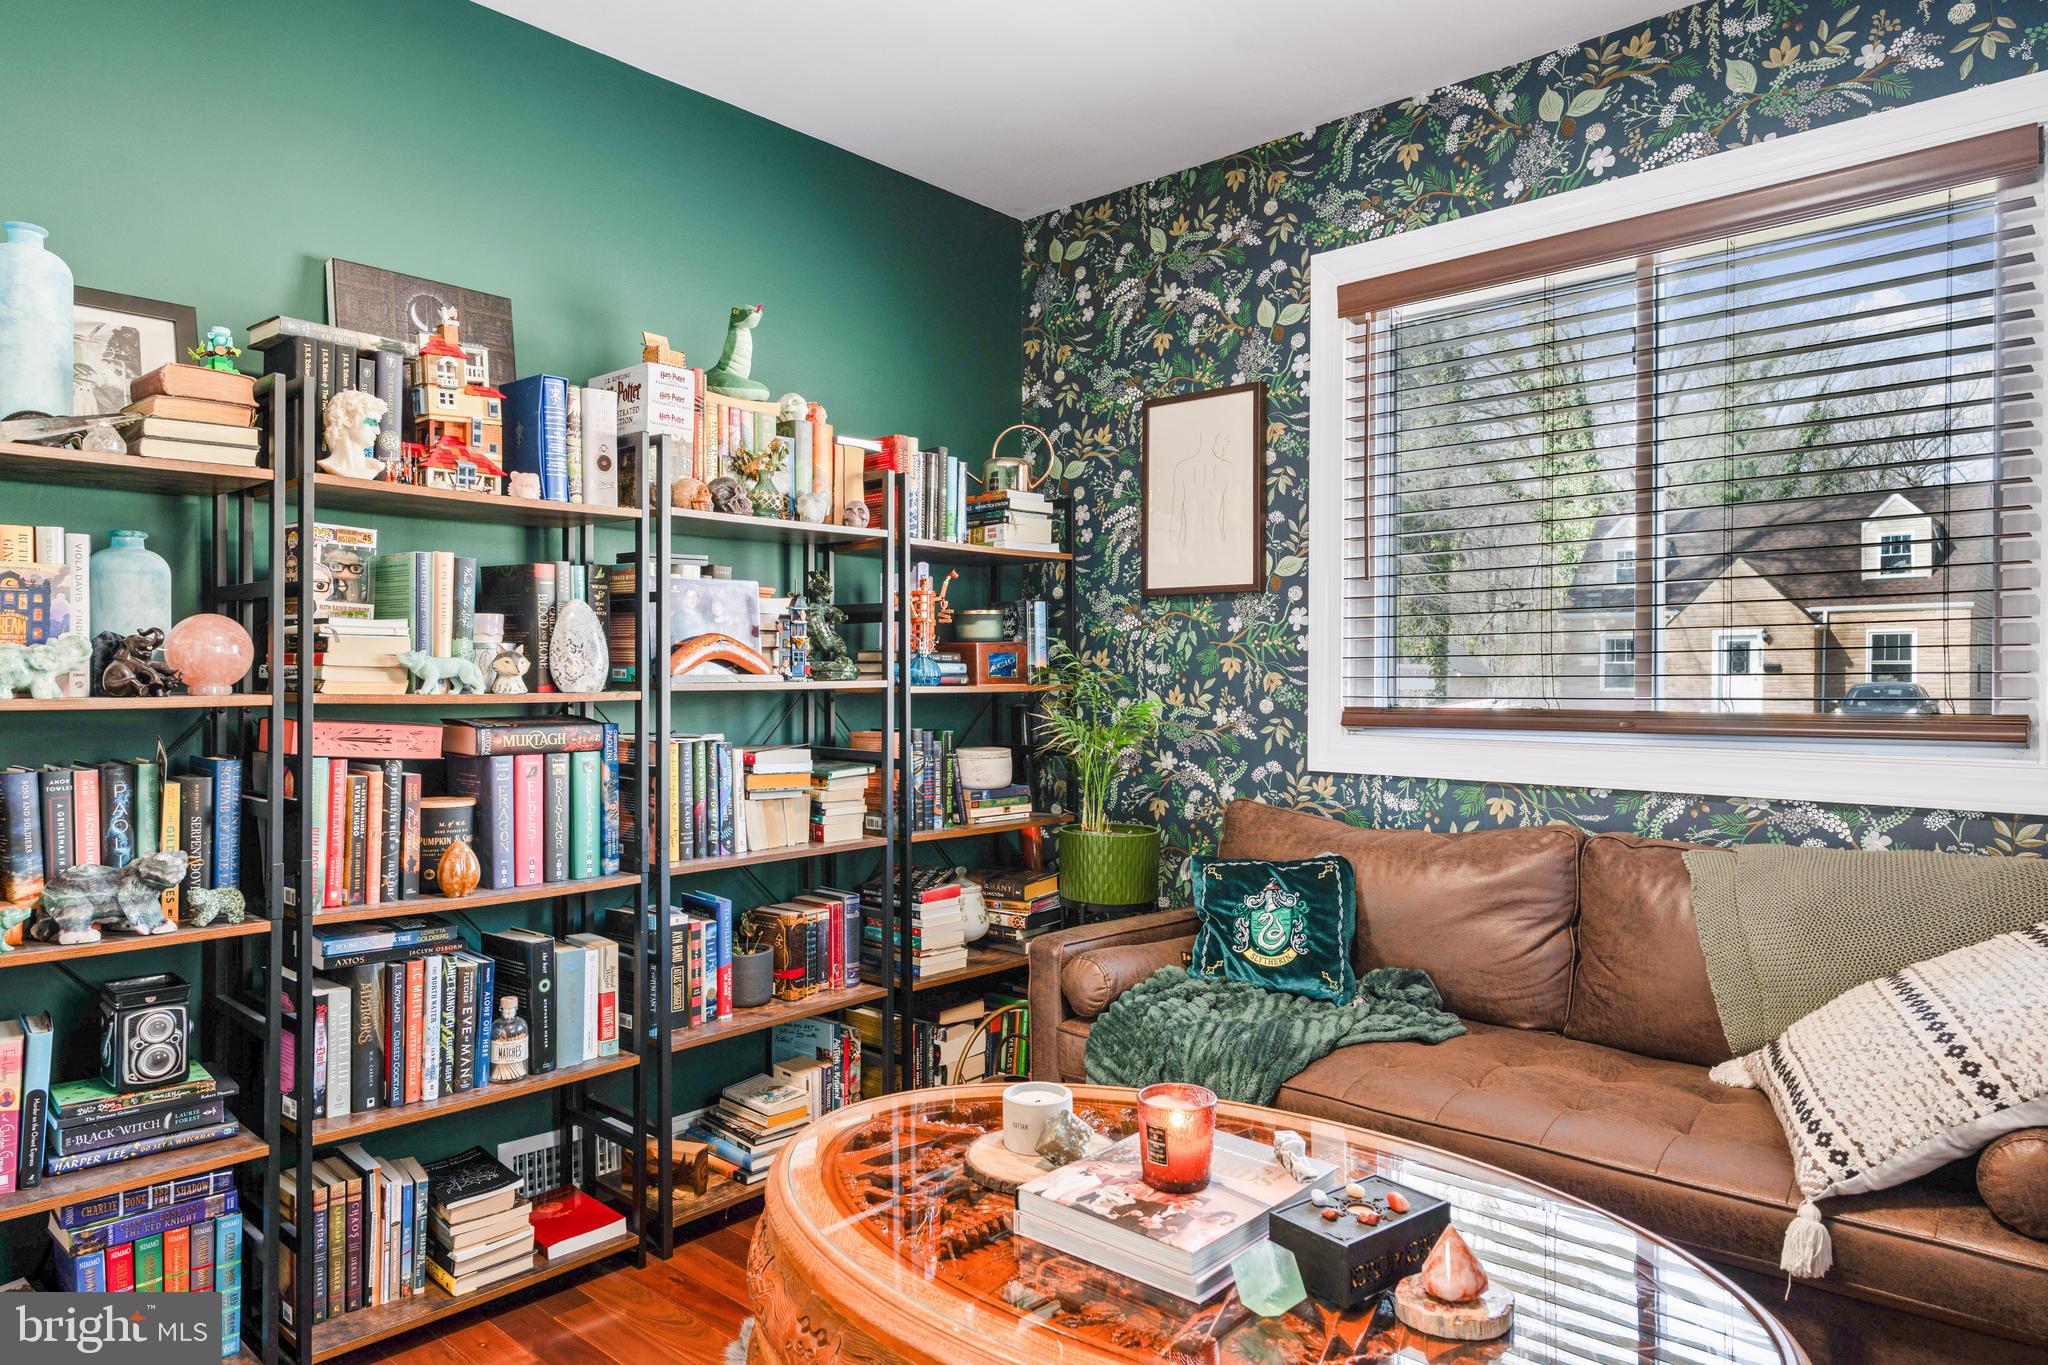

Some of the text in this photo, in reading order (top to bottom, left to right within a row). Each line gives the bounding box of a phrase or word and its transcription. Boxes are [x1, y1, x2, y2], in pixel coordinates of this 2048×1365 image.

[612, 372, 631, 382] ROWLING
[672, 373, 686, 383] Potter
[617, 381, 642, 403] Potter
[672, 394, 686, 404] Potter
[671, 414, 685, 424] Potter
[362, 533, 373, 543] 45
[75, 543, 83, 602] VIOLA DAVIS
[440, 571, 448, 635] PLACE FOR US
[456, 586, 473, 628] Paris Slept
[538, 593, 549, 670] BLOOD BONE
[990, 655, 1016, 673] ACID
[503, 729, 567, 750] MURTAGH
[605, 728, 614, 762] PAOLINI
[220, 766, 232, 813] SCHWAB
[333, 786, 342, 815] WHITE
[390, 787, 398, 812] SHOULD
[606, 770, 619, 821] ERAGON
[22, 780, 33, 854] SONS AND SOLDIERS
[353, 784, 362, 837] EVELYN HUGO
[390, 814, 398, 822] BE
[497, 785, 510, 853] ERAGON
[528, 780, 537, 848] ELDEST
[555, 778, 564, 849] BRISINGR
[57, 810, 66, 855] GENTLEMAN
[332, 818, 341, 842] LADY
[389, 825, 397, 841] WILD
[710, 801, 718, 846] GUEST LIST
[85, 812, 95, 866] JACQUELINE
[191, 816, 202, 861] SERPENT
[219, 814, 231, 872] OF ADDIE
[420, 833, 461, 847] PUMPKIN &
[58, 857, 66, 867] IN
[387, 880, 395, 896] FINE
[416, 932, 449, 943] GOLDBERG
[420, 927, 446, 937] LORETTA
[409, 943, 463, 956] JACLYN OSBORN
[672, 930, 684, 962] AYN RAND
[335, 955, 366, 967] AXIOS
[1250, 952, 1293, 966] SLYTHERIN
[412, 966, 422, 1020] J.C. MAETIS
[430, 975, 439, 1024] NORTH WATER
[446, 961, 457, 1029] JANET EVANOVICH
[673, 968, 683, 1010] ATLAS SHRUGGED
[483, 991, 491, 1018] ALONE
[602, 1006, 615, 1040] NATIVE SON
[393, 972, 402, 1102] S.L. ROWLAND CURSED COCKTAILS
[460, 1006, 473, 1078] EVE MAN
[482, 1038, 490, 1058] HERE
[338, 1014, 349, 1090] LITTLE LIFE
[445, 1036, 453, 1082] RECOVERY AGENT
[498, 1044, 523, 1060] MATCHES
[833, 1072, 841, 1100] KITCHEN
[32, 1098, 40, 1116] Murder
[175, 1109, 201, 1119] LAURIE
[175, 1115, 201, 1126] FOREST
[30, 1131, 39, 1147] Orient
[75, 1118, 161, 1148] BLACK WITCH
[140, 1144, 151, 1153] GO
[152, 1141, 166, 1151] SET
[175, 1131, 217, 1146] WATCHMAN
[28, 1149, 38, 1168] Express
[54, 1149, 127, 1173] HARPER LEE
[81, 1180, 209, 1218] CHARLIE BONE AND SHADOW
[154, 1194, 169, 1204] THE
[119, 1210, 182, 1233] CHARLIE BONE
[124, 1213, 198, 1239] THE RED KNIGHT
[193, 1224, 213, 1236] NIMMO
[221, 1217, 240, 1229] NIMMO
[316, 1212, 324, 1250] INFIDEL
[348, 1202, 360, 1239] CHAOS
[139, 1239, 159, 1251] NIMMO
[167, 1232, 188, 1244] NIMMO
[79, 1257, 100, 1270] NIMMO
[110, 1246, 131, 1260] NIMMO
